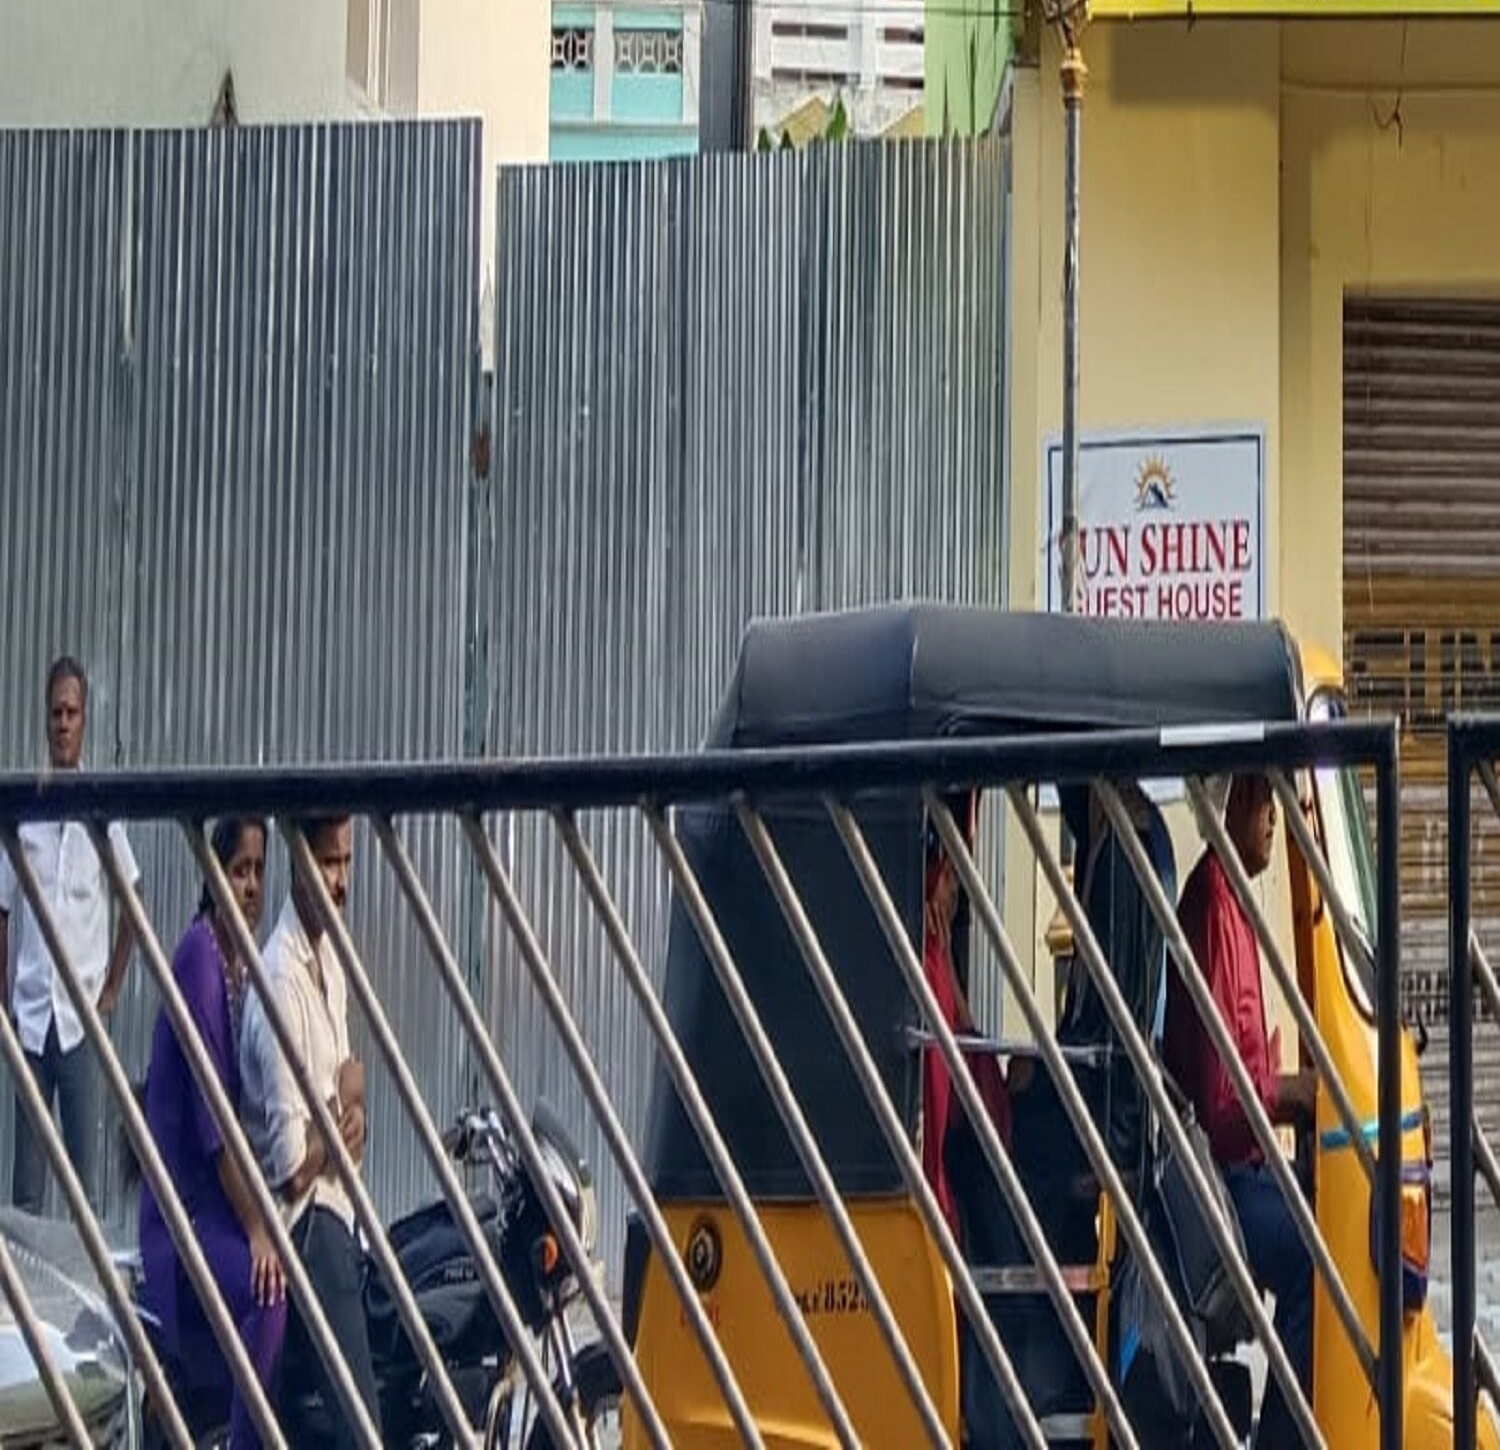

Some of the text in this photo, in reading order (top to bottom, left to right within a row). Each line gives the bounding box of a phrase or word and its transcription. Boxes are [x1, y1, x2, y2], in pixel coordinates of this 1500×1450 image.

[1062, 518, 1252, 577] UN SHINE
[1157, 579, 1243, 618] HOUSE
